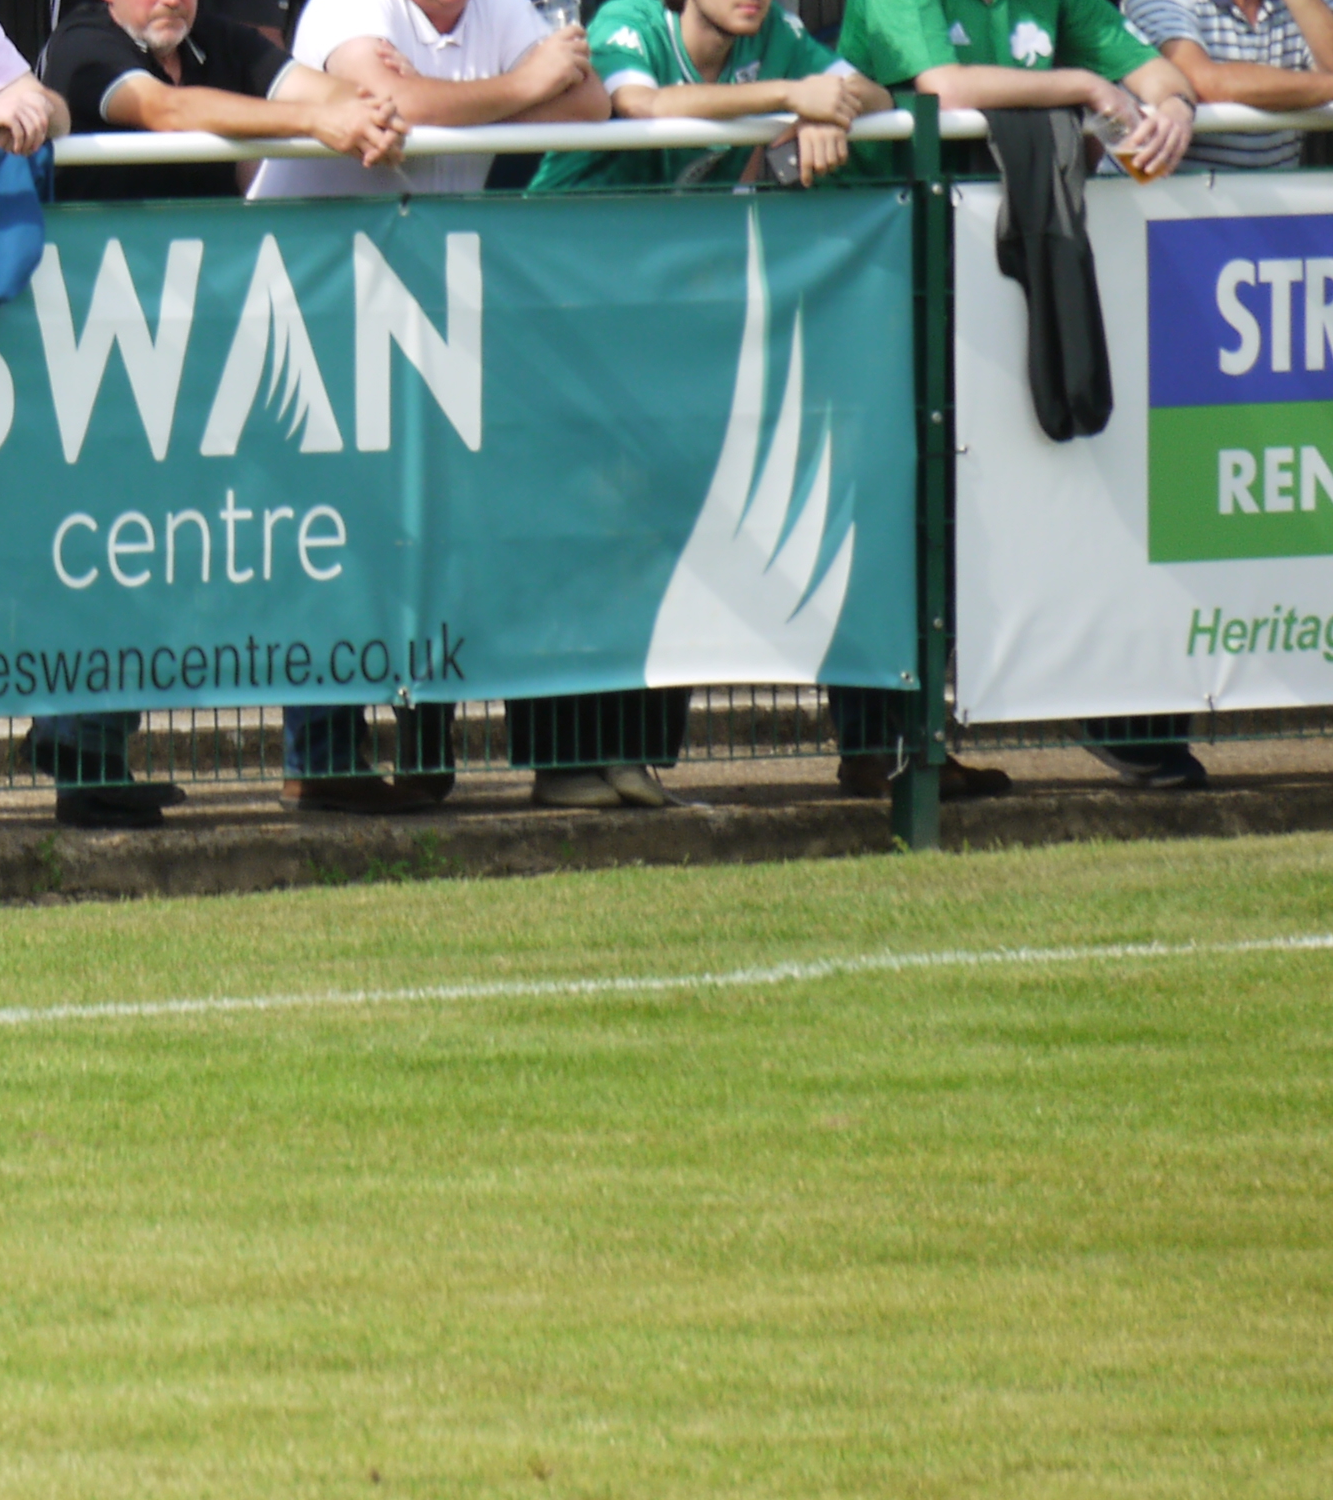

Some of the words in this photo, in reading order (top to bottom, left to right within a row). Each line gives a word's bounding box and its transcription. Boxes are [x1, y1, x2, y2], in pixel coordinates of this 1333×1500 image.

[1216, 258, 1333, 376] STR
[1219, 446, 1333, 515] REN
[52, 488, 347, 589] centre
